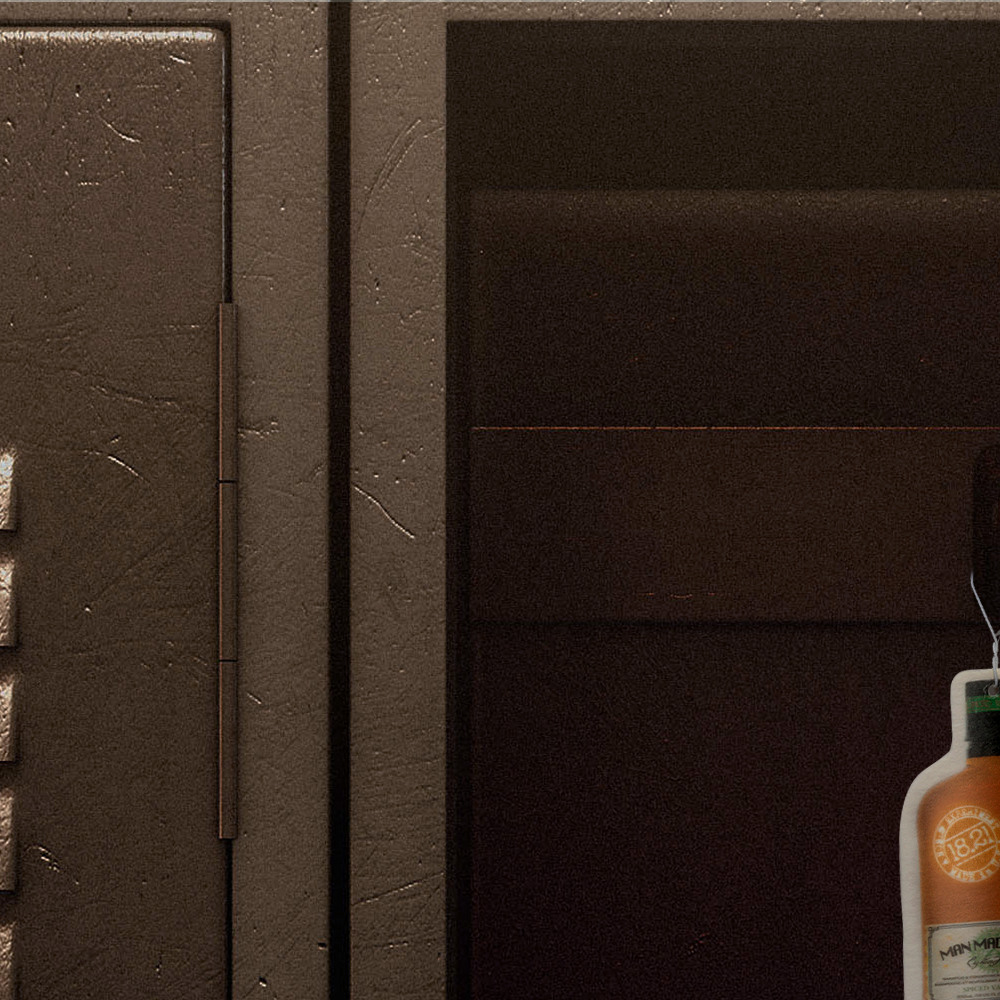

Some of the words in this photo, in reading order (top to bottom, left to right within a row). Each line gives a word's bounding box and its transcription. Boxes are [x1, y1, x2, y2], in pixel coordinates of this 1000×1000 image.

[947, 825, 995, 861] 18.21
[939, 941, 972, 961] MAN
[962, 985, 990, 993] SPICED
